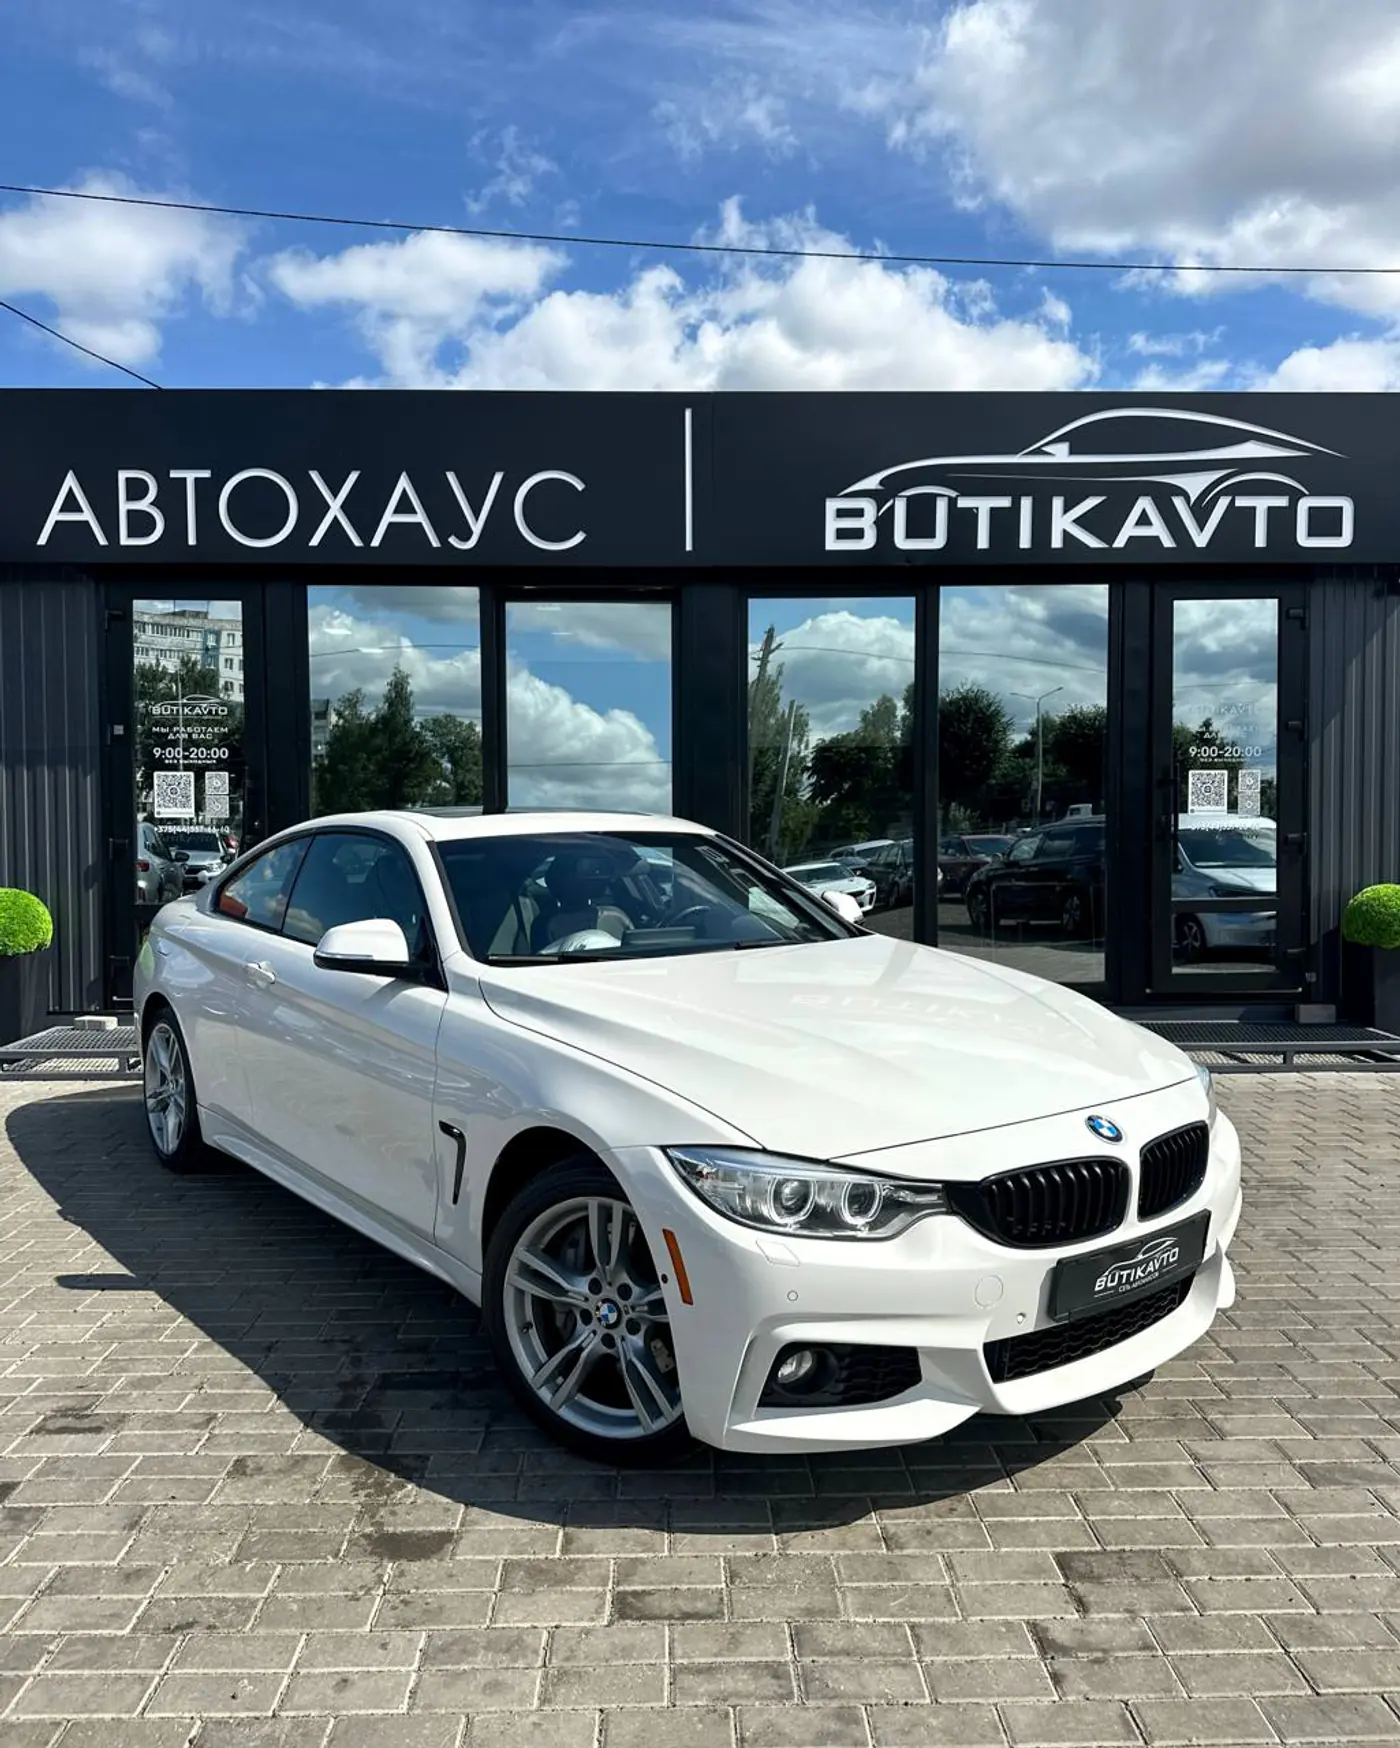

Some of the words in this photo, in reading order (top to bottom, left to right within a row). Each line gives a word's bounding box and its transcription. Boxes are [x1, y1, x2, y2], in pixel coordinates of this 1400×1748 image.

[36, 467, 587, 551] АВТОХАУС
[824, 494, 1355, 551] BUTIKAVTO
[152, 705, 228, 716] BUTIKAVTO
[152, 747, 229, 759] 9:00-20:00
[1189, 746, 1262, 757] 9:00-20:00
[1094, 1247, 1179, 1291] BUTIKAVTO
